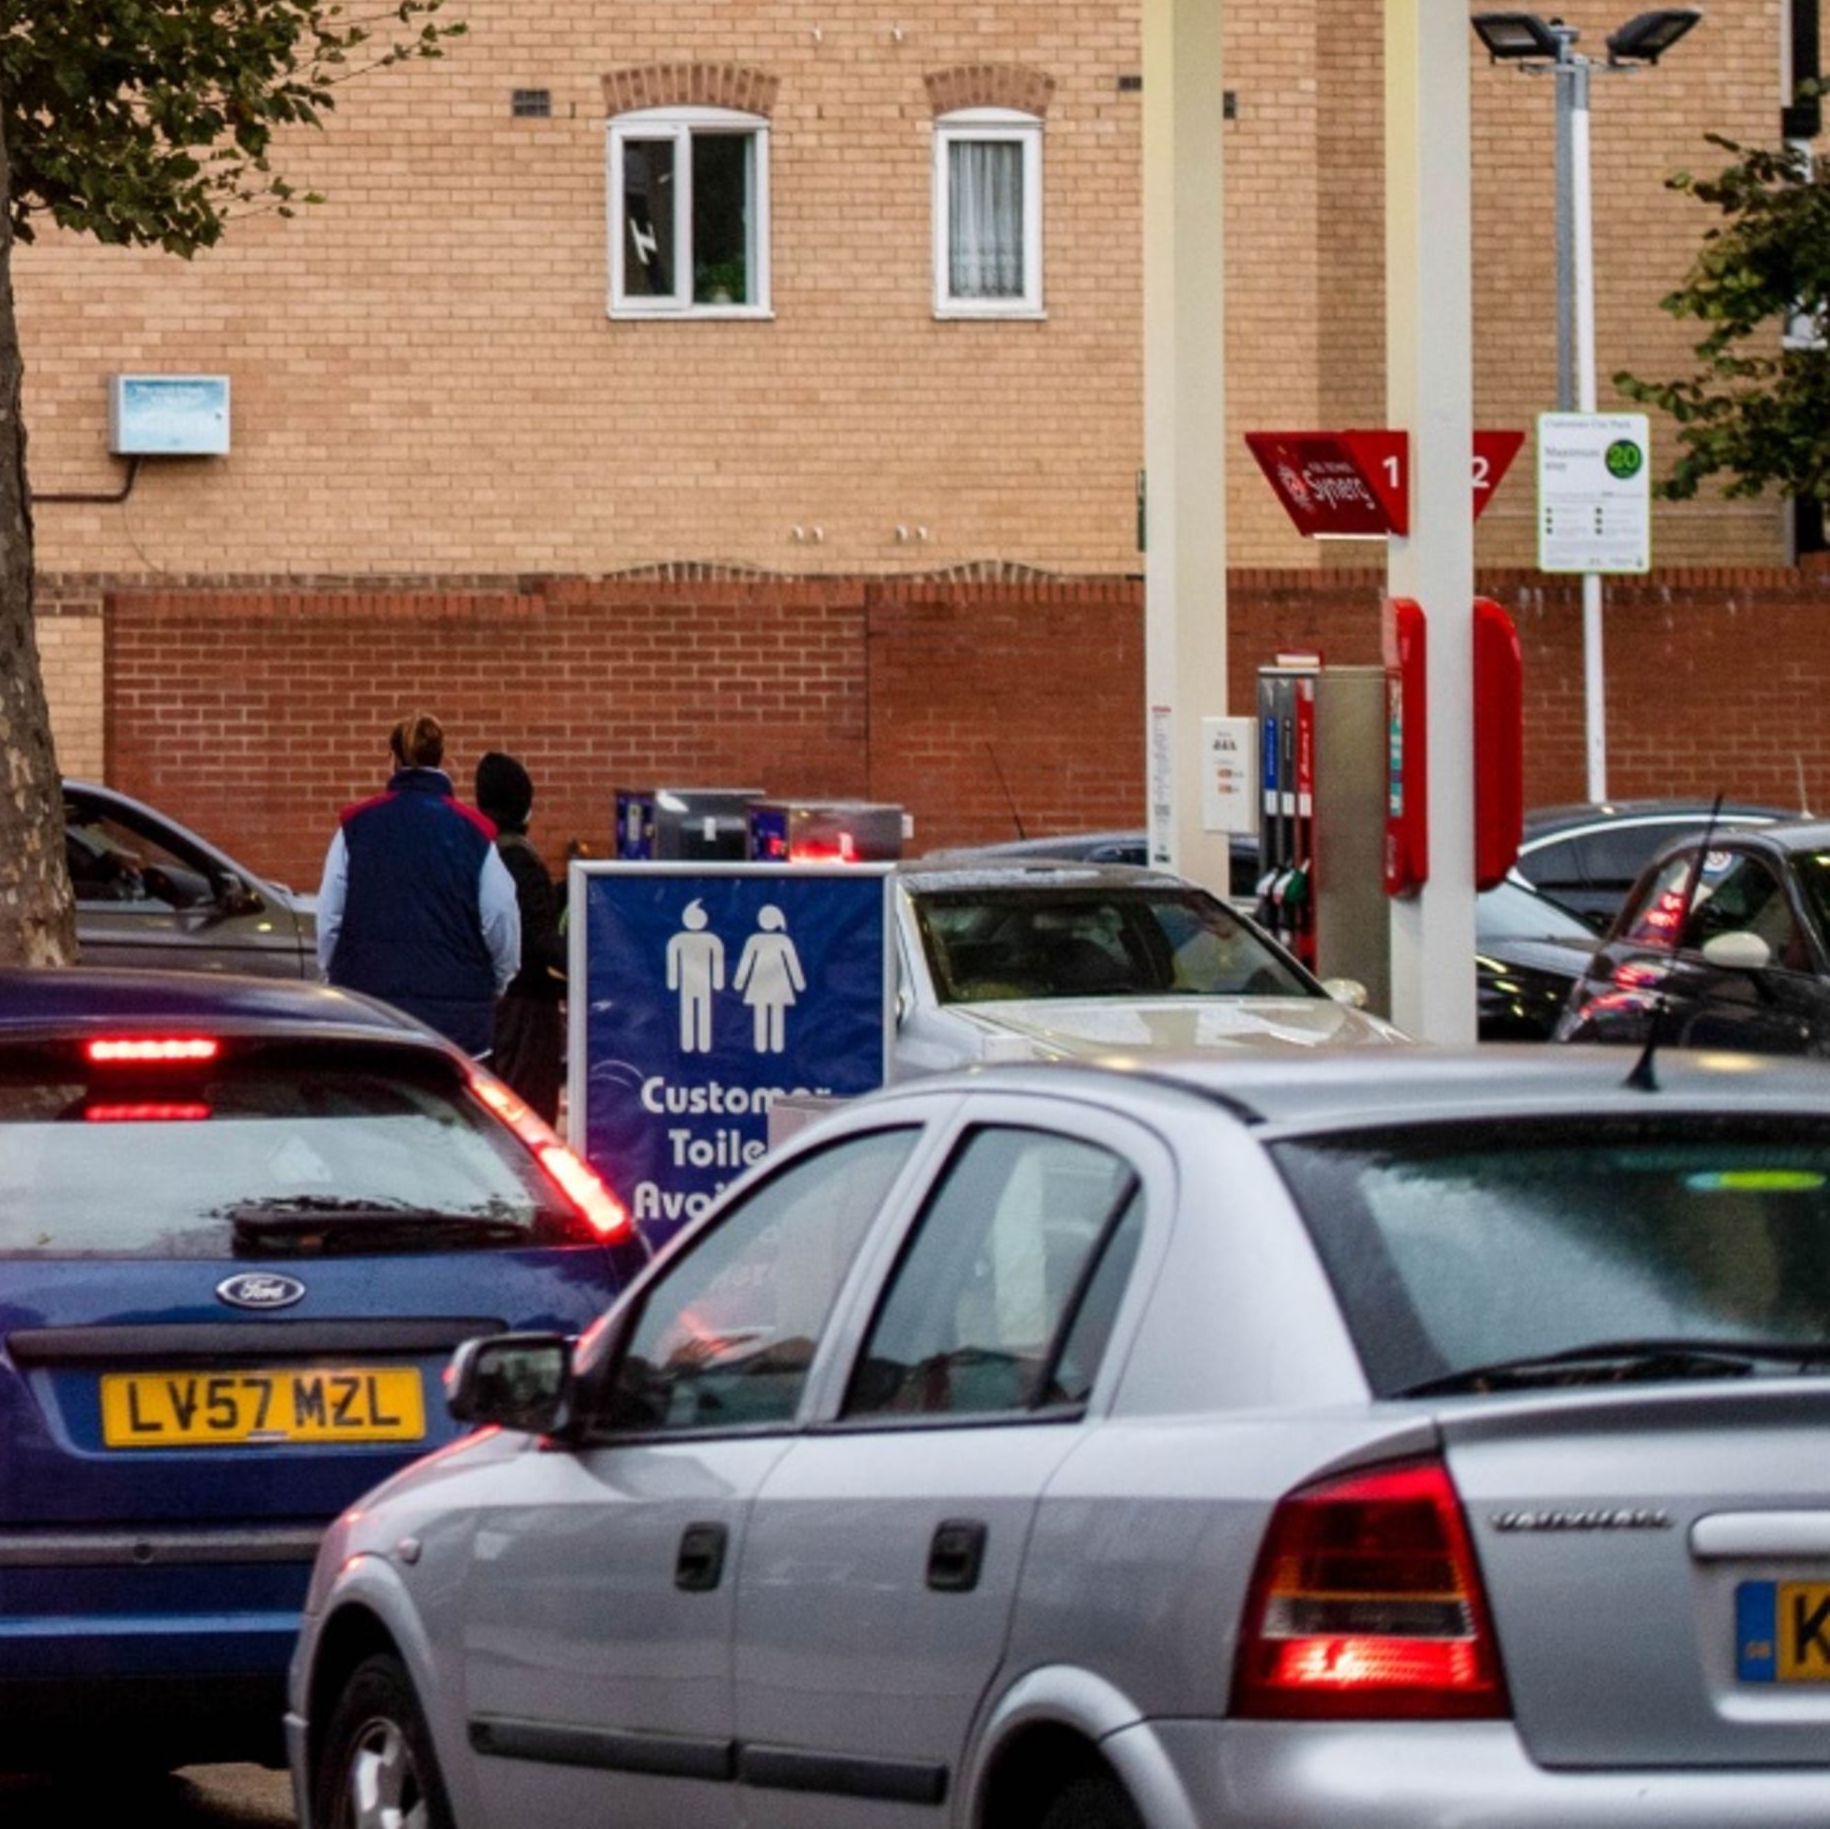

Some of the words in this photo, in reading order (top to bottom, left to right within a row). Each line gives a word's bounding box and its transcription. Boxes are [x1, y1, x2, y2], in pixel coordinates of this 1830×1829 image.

[1382, 456, 1398, 488] 1
[1472, 457, 1490, 488] 2
[241, 1281, 285, 1299] Ford
[128, 1379, 272, 1431] LV57
[293, 1376, 400, 1427] MZL
